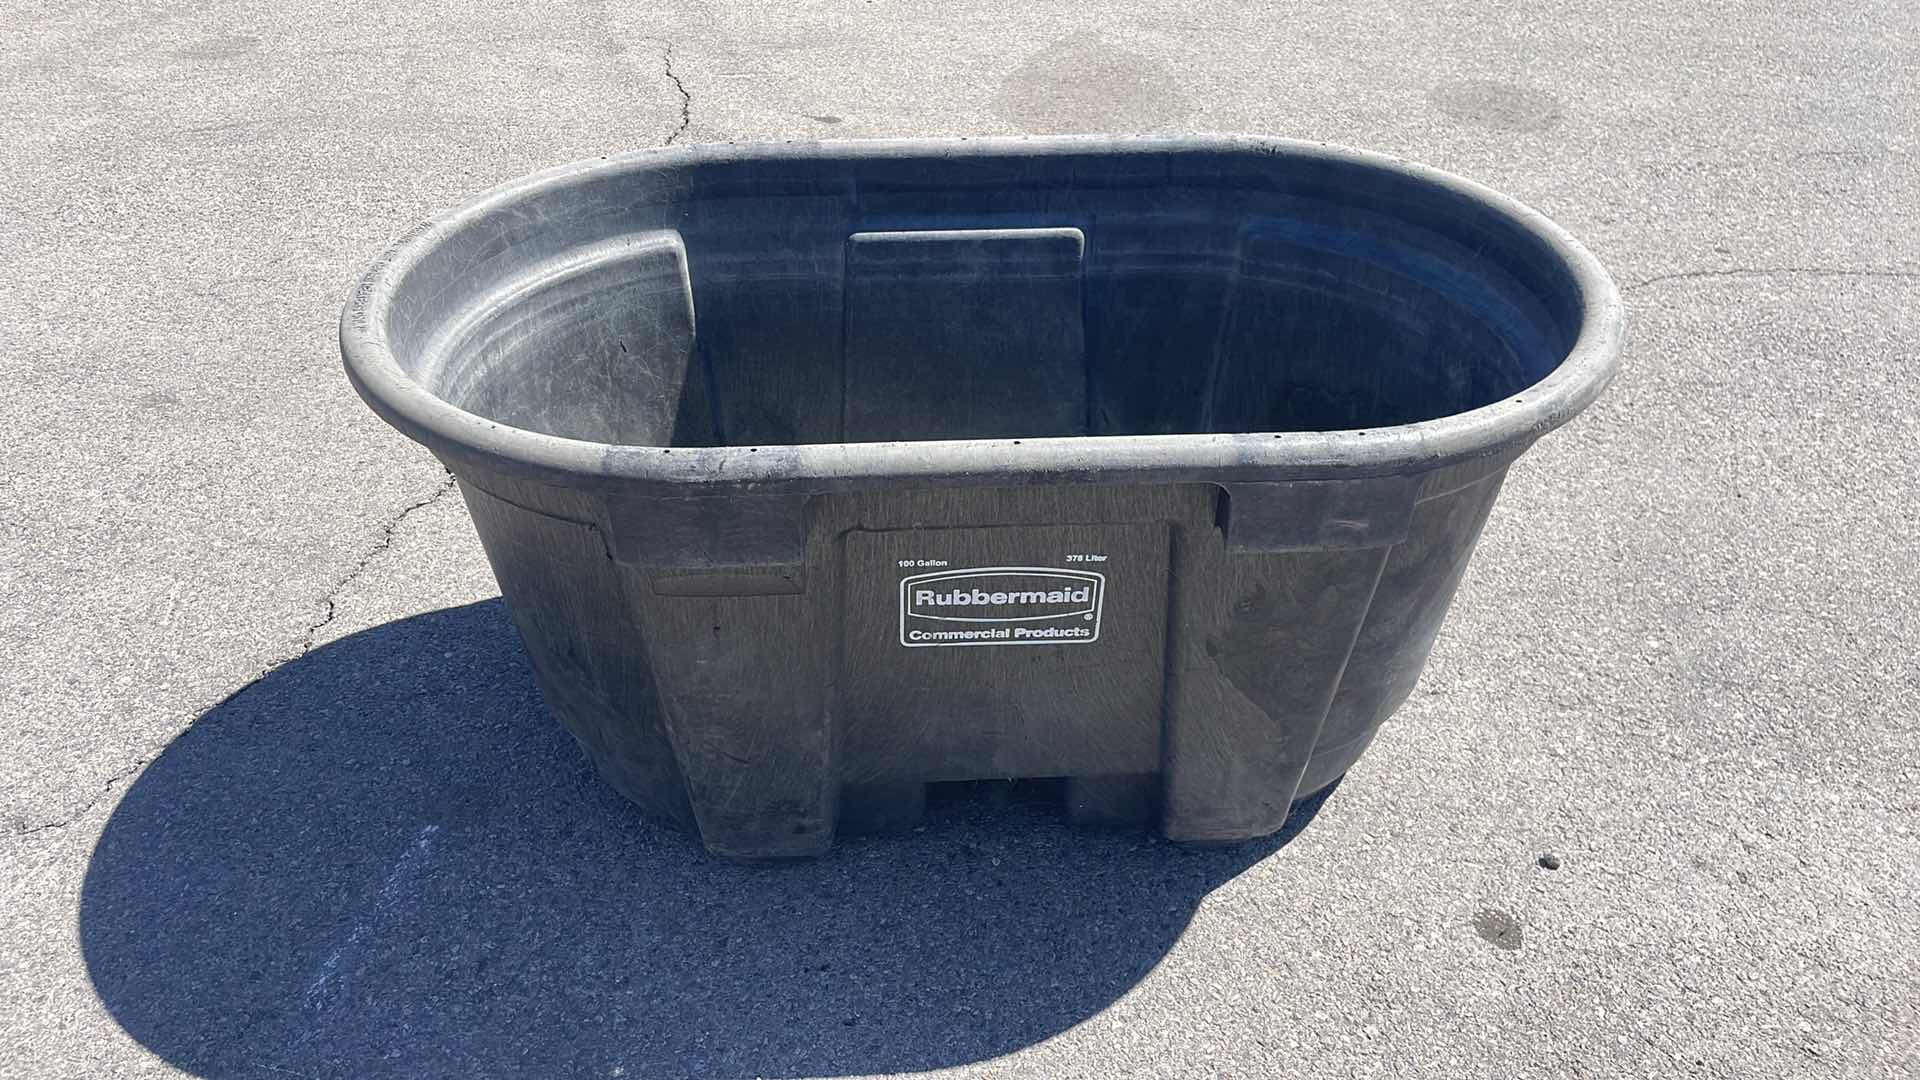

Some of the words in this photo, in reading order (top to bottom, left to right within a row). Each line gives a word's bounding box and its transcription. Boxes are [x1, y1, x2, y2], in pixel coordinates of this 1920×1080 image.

[898, 560, 915, 568] 100
[917, 559, 948, 567] Gallon
[1085, 554, 1108, 562] Liter
[915, 587, 1090, 606] Rubbermaid
[909, 628, 1010, 641] Commercial
[1014, 626, 1090, 639] Products
